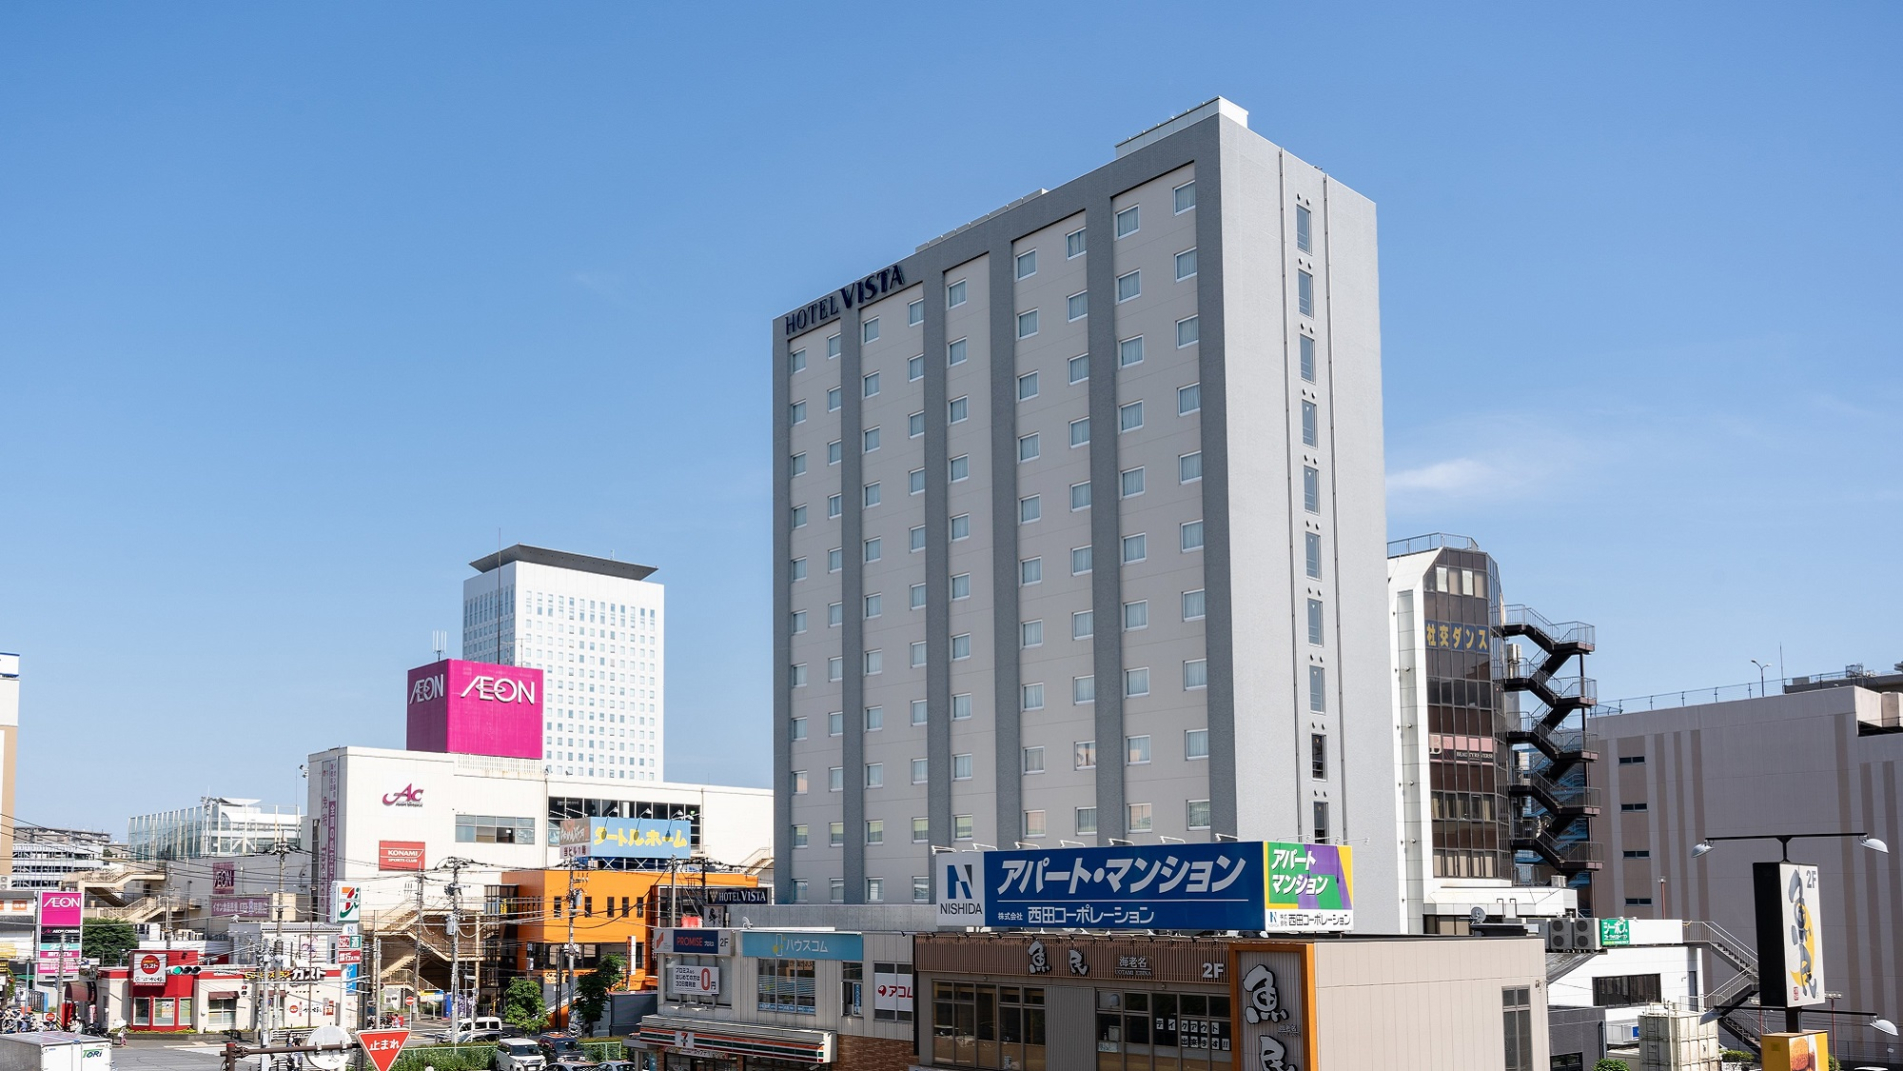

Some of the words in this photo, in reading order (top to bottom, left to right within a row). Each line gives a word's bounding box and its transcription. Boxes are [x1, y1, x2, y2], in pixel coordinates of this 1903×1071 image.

[785, 296, 839, 335] HOTEL
[839, 264, 905, 309] VISTA
[1426, 623, 1488, 651] 社交ダンス
[594, 826, 688, 848] タートルホーム
[387, 849, 418, 857] KONAMI
[1271, 848, 1316, 870] アパート
[1272, 874, 1329, 895] マンション
[1806, 870, 1817, 889] 2F
[719, 892, 741, 902] HOTEL
[741, 890, 766, 902] VISTA
[940, 903, 982, 915] NISHIDA
[998, 912, 1023, 921] 株式会社
[1028, 903, 1154, 924] 西田コーポレーション
[1288, 912, 1350, 926] 西田コーポレーション
[676, 937, 703, 947] PROMISE
[720, 938, 729, 947] 2F
[786, 939, 828, 952] ハウスコム
[1120, 956, 1147, 968] 海老名
[291, 967, 326, 981] ガスト
[1202, 962, 1224, 979] 2F
[701, 968, 711, 991] 0
[711, 981, 716, 990] 円
[1156, 1018, 1219, 1034] テイクアウト
[369, 1039, 400, 1051] 止まれ
